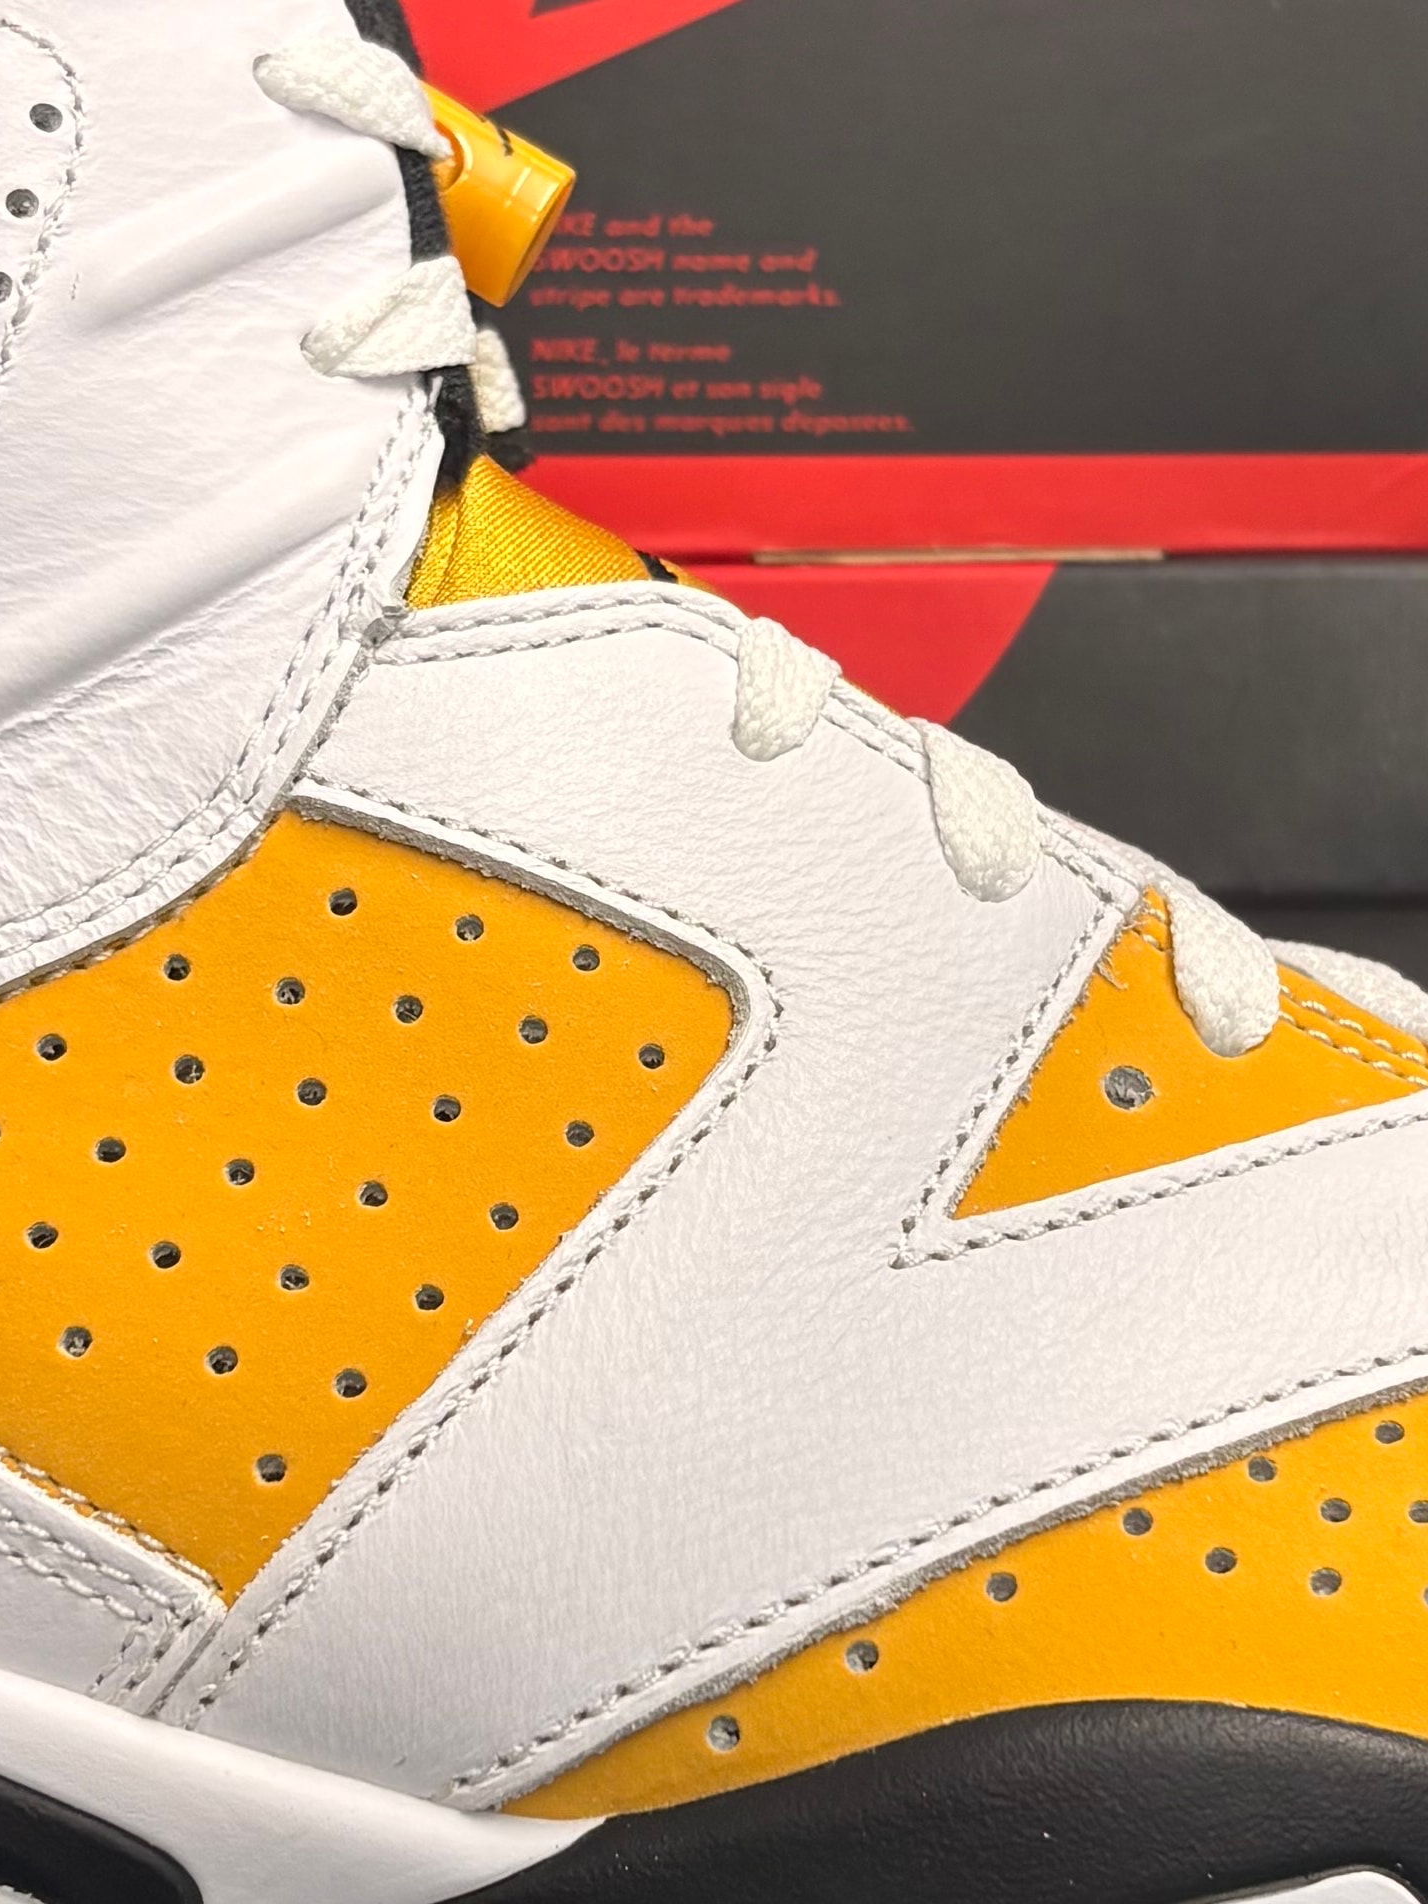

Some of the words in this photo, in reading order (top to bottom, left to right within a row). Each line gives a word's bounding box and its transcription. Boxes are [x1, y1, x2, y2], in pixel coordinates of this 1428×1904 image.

[603, 214, 662, 237] and
[667, 213, 714, 237] the
[672, 254, 750, 273] name
[759, 246, 818, 273] and
[531, 286, 611, 312] stripe
[618, 289, 665, 307] are
[647, 341, 732, 363] terme
[531, 374, 666, 400] SWOOSH
[598, 409, 646, 433] des
[653, 415, 773, 437] marques
